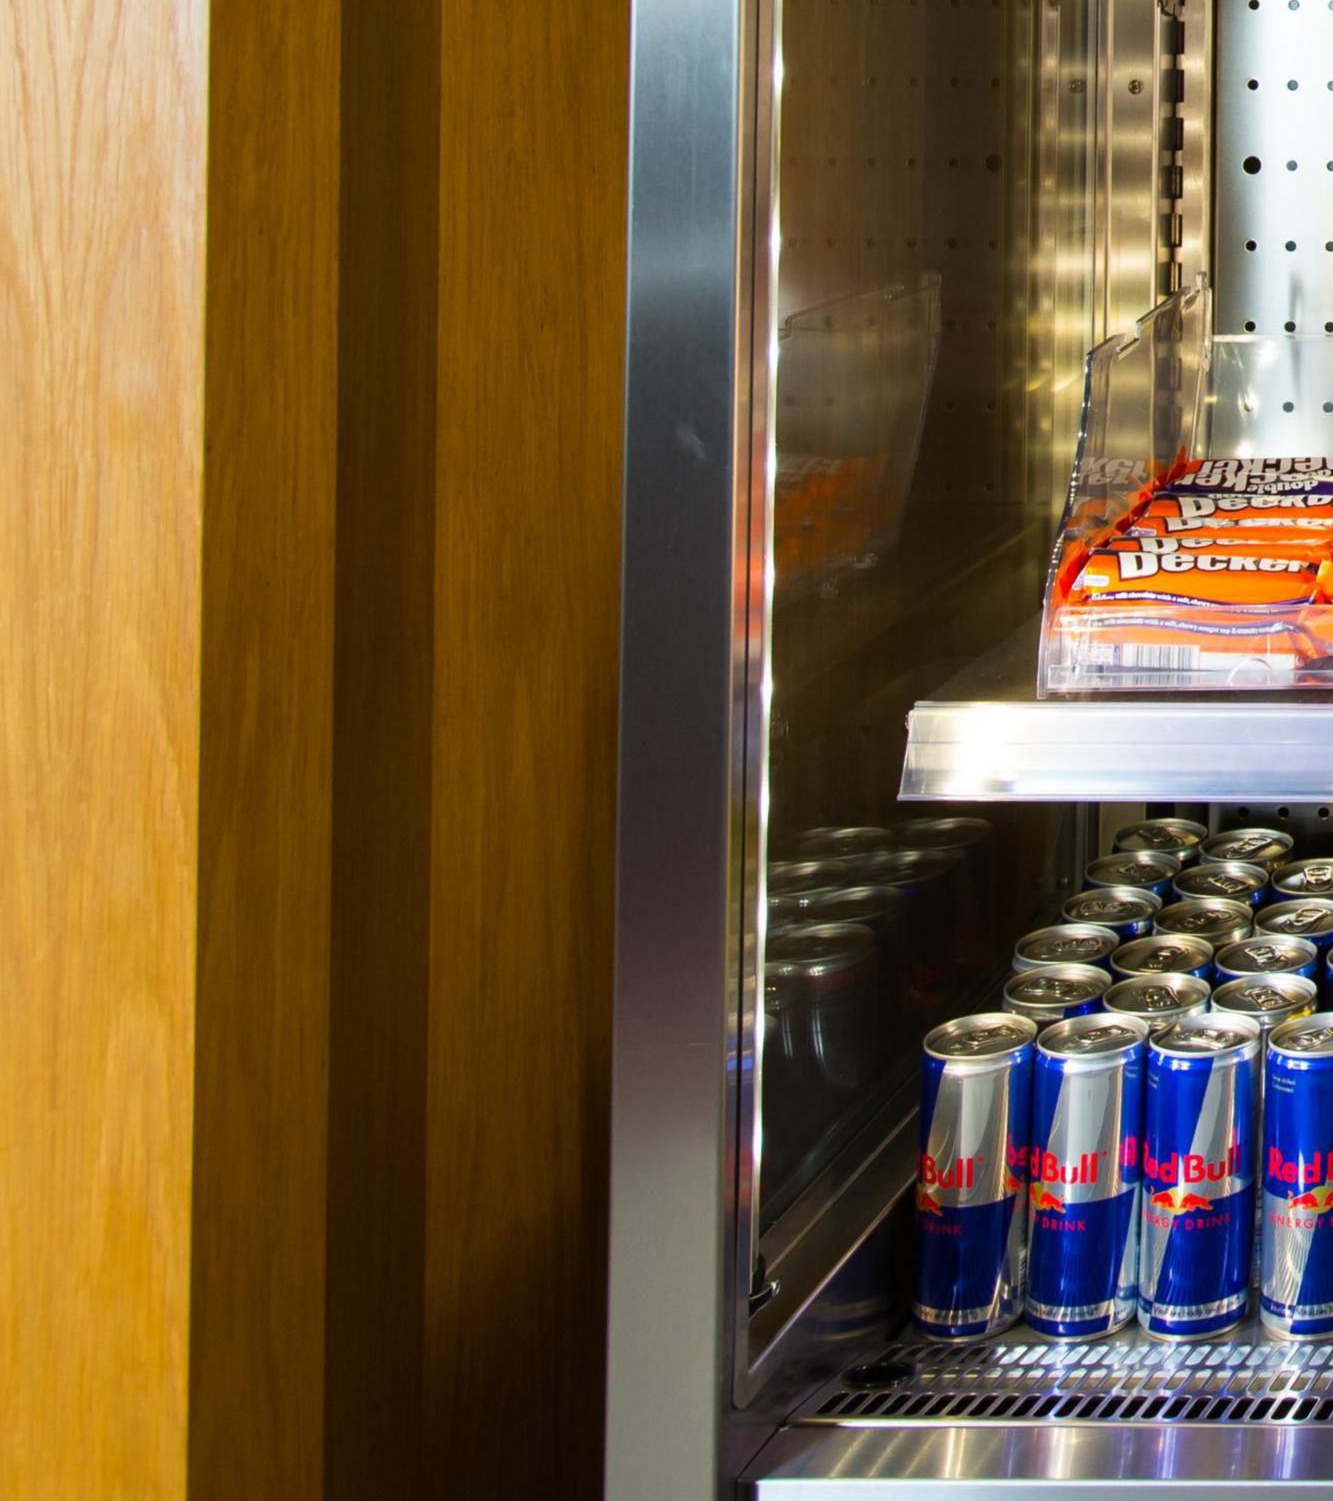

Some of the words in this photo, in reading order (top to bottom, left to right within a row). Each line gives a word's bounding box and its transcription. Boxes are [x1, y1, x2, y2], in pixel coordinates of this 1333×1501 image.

[1118, 549, 1310, 581] Decker
[922, 1154, 976, 1190] Bull
[1041, 1151, 1099, 1185] Bull
[1183, 1143, 1242, 1184] Bull
[1268, 1145, 1322, 1184] Red
[1041, 1216, 1087, 1233] DRINK
[1184, 1211, 1232, 1231] DRINK
[1269, 1211, 1324, 1230] ENERGY
